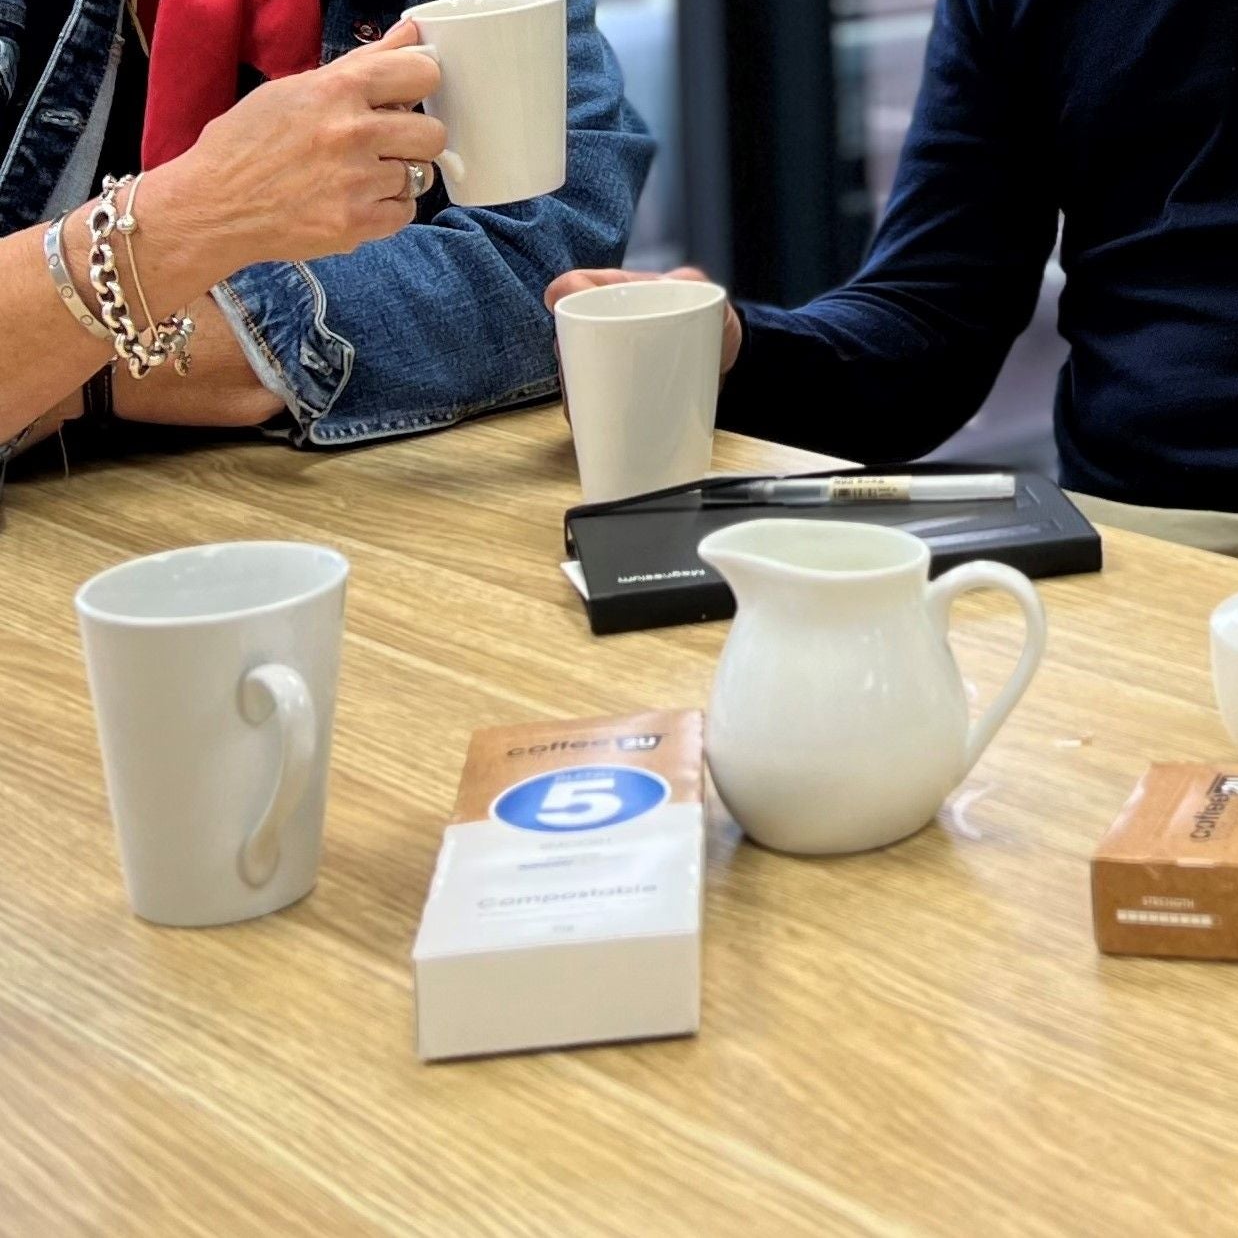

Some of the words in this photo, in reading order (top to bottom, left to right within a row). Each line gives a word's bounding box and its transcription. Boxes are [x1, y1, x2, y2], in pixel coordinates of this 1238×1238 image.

[506, 739, 609, 757] coffee
[535, 778, 623, 827] 5
[1188, 789, 1231, 842] coffee
[476, 882, 658, 910] Compostable
